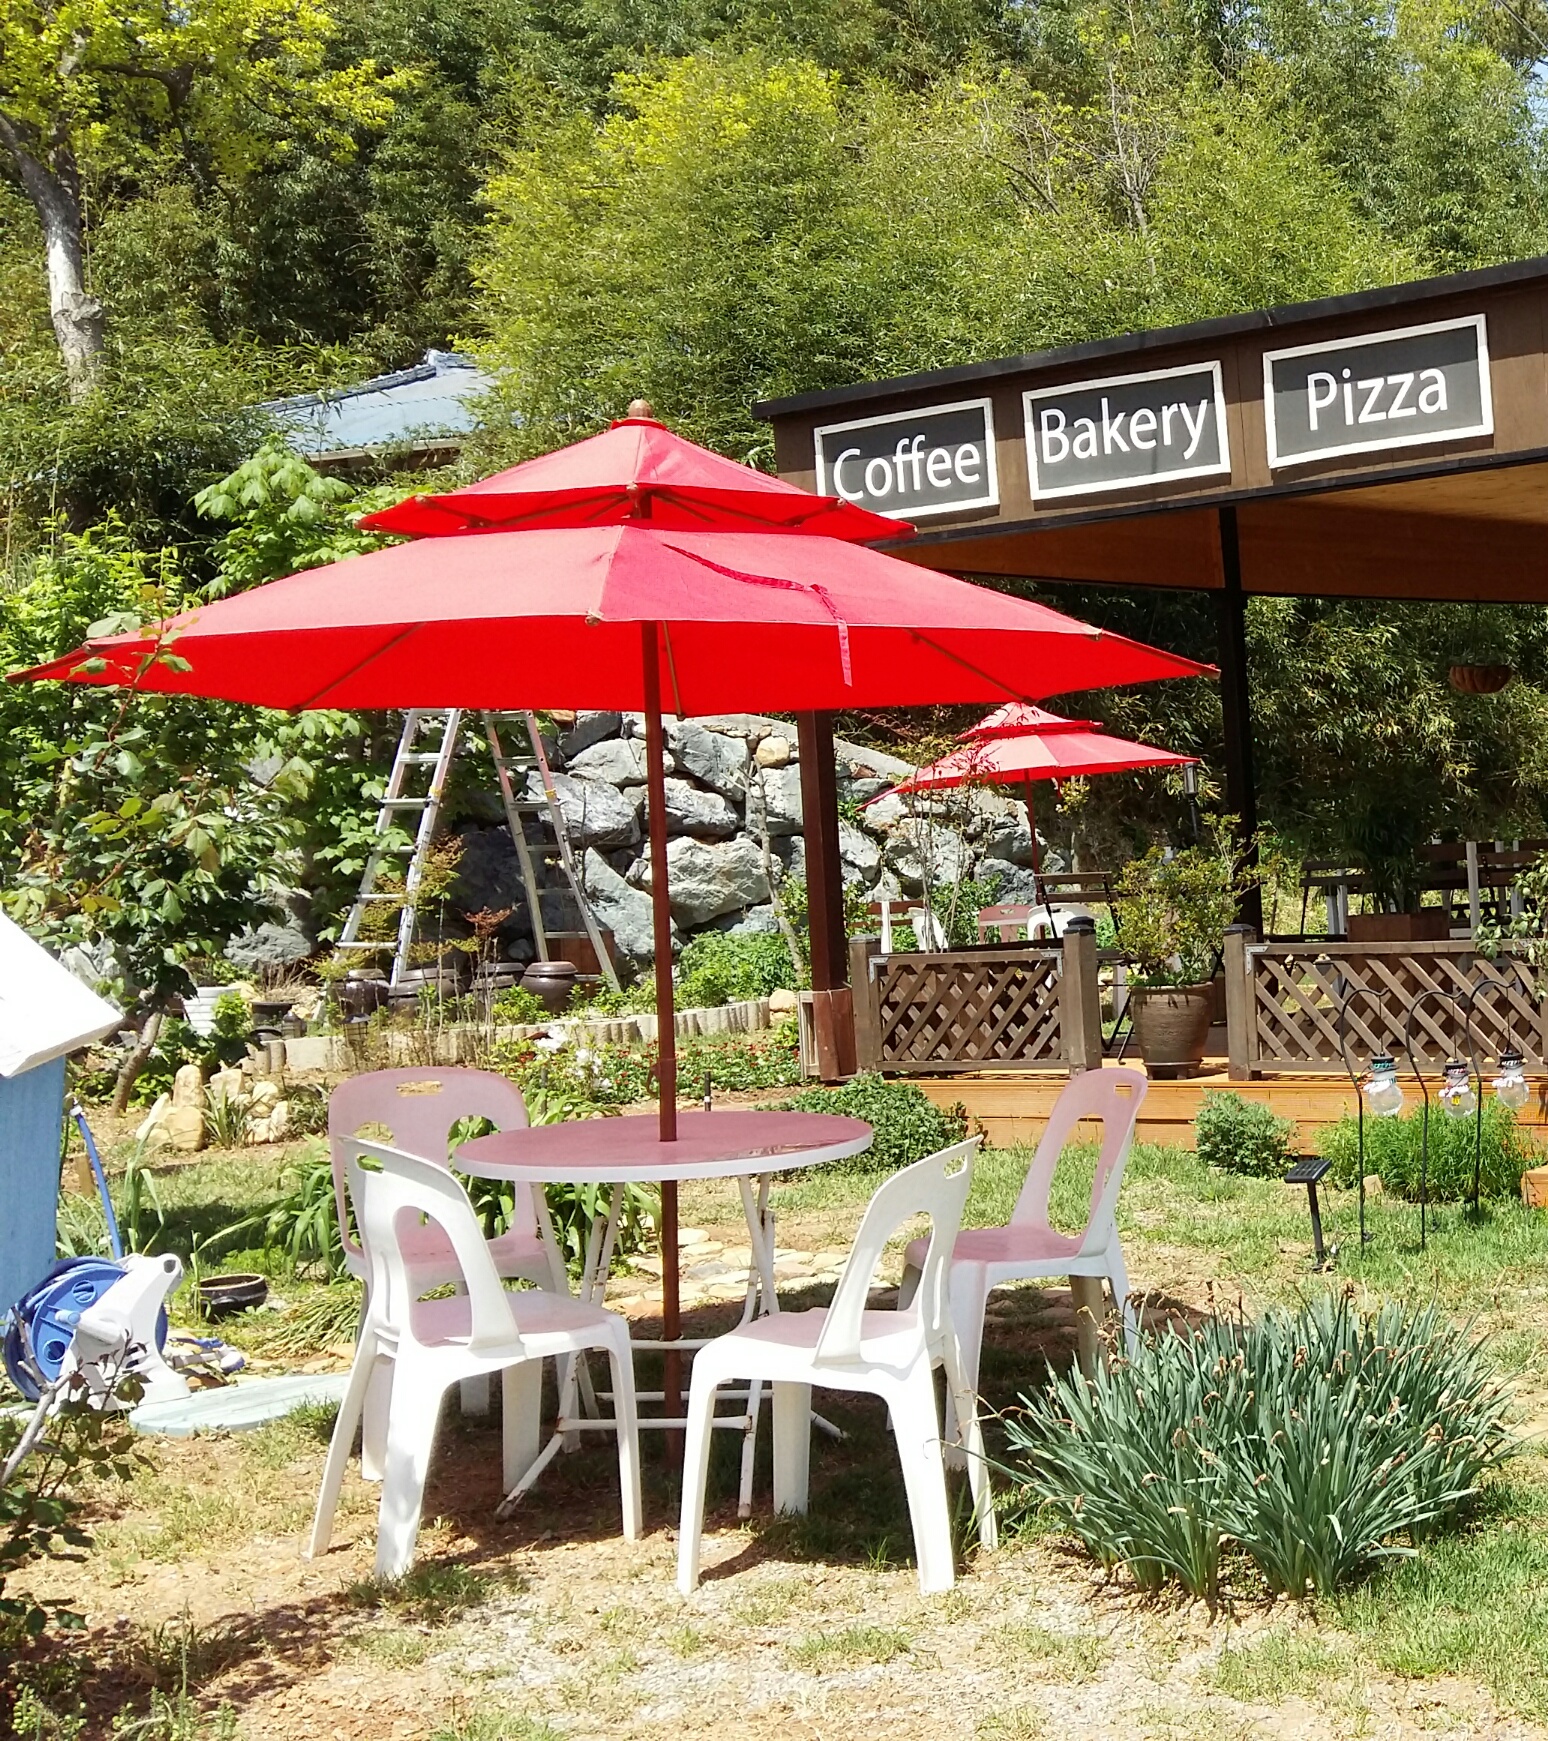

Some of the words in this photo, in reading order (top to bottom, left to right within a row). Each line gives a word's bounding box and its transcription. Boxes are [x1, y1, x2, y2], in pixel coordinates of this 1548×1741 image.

[1040, 396, 1209, 466] Bakery
[1306, 367, 1450, 432] Pizza
[832, 434, 981, 500] Coffee
